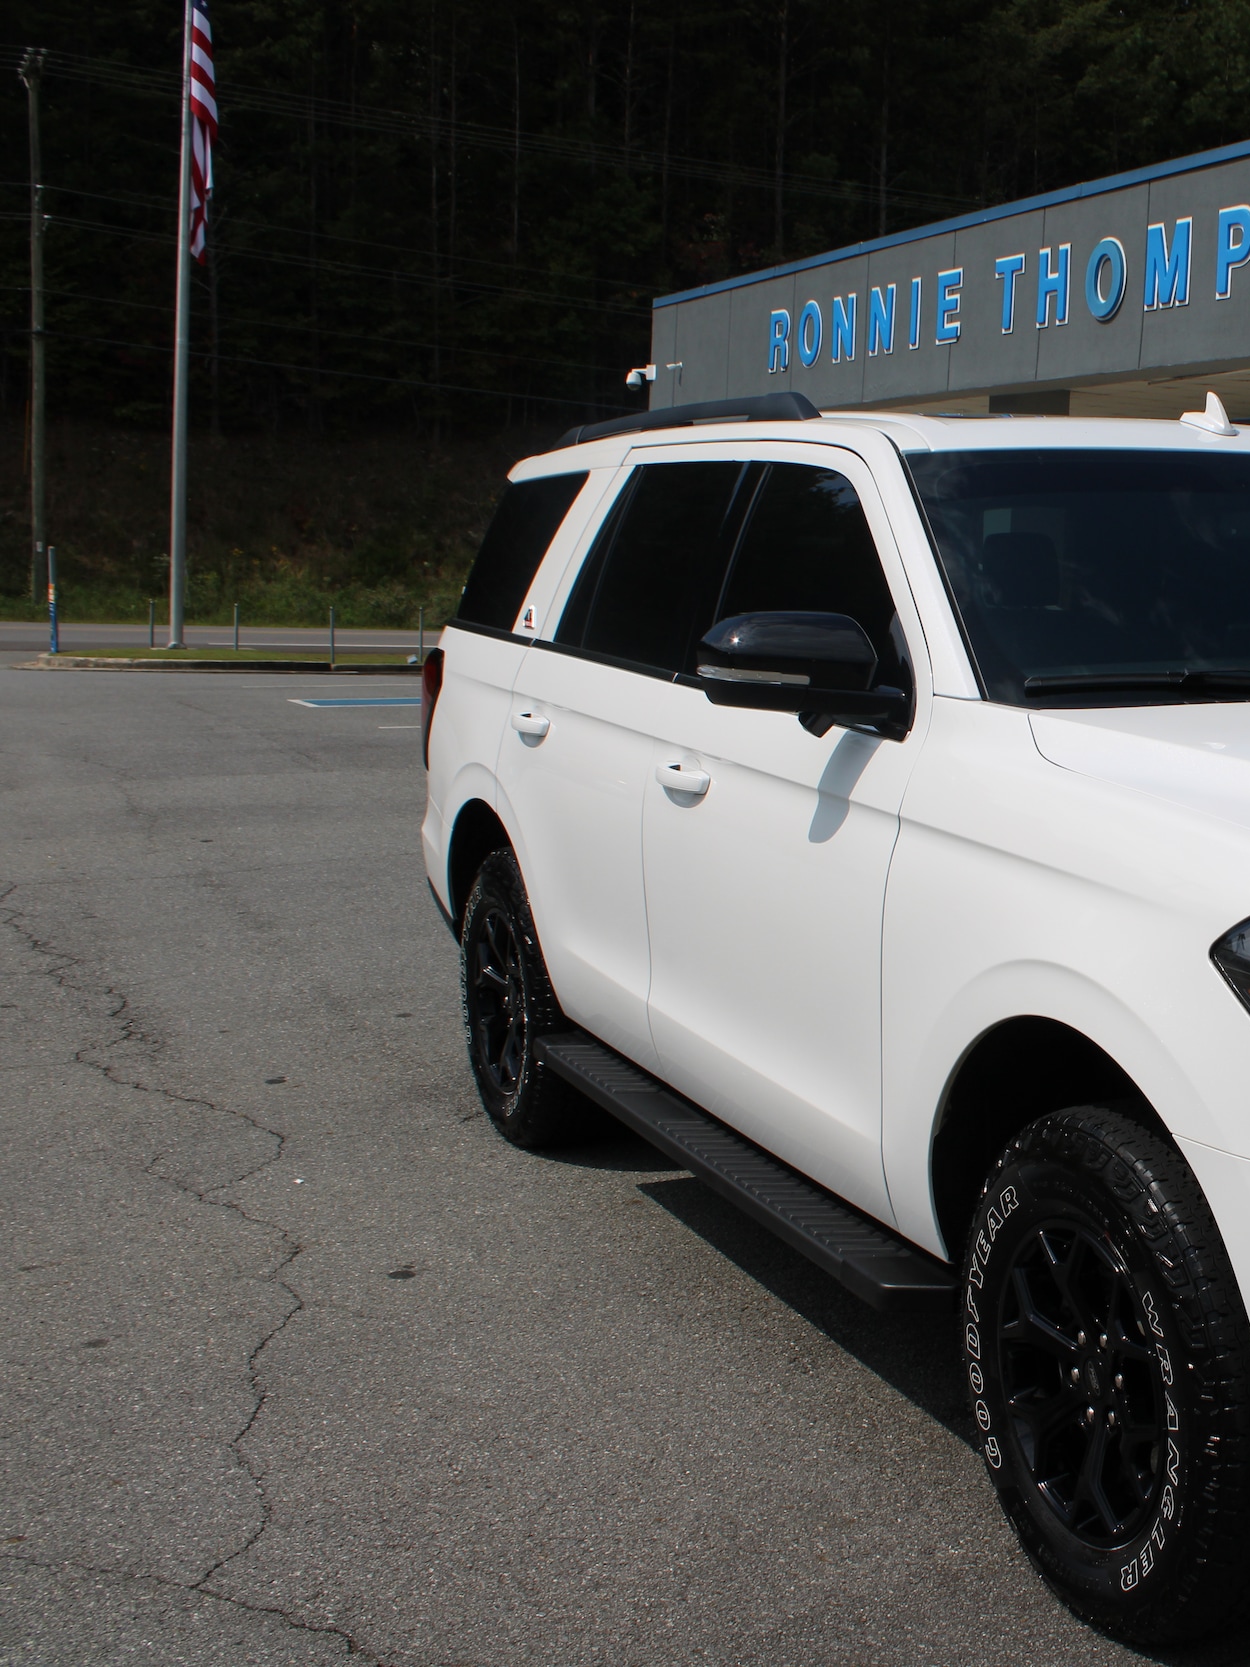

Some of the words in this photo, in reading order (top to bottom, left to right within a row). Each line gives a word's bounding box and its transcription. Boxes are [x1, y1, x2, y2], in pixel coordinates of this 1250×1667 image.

[768, 267, 964, 375] RONNIE
[966, 1184, 1020, 1469] GOODYEAR
[1120, 1291, 1181, 1592] WRANGLER
